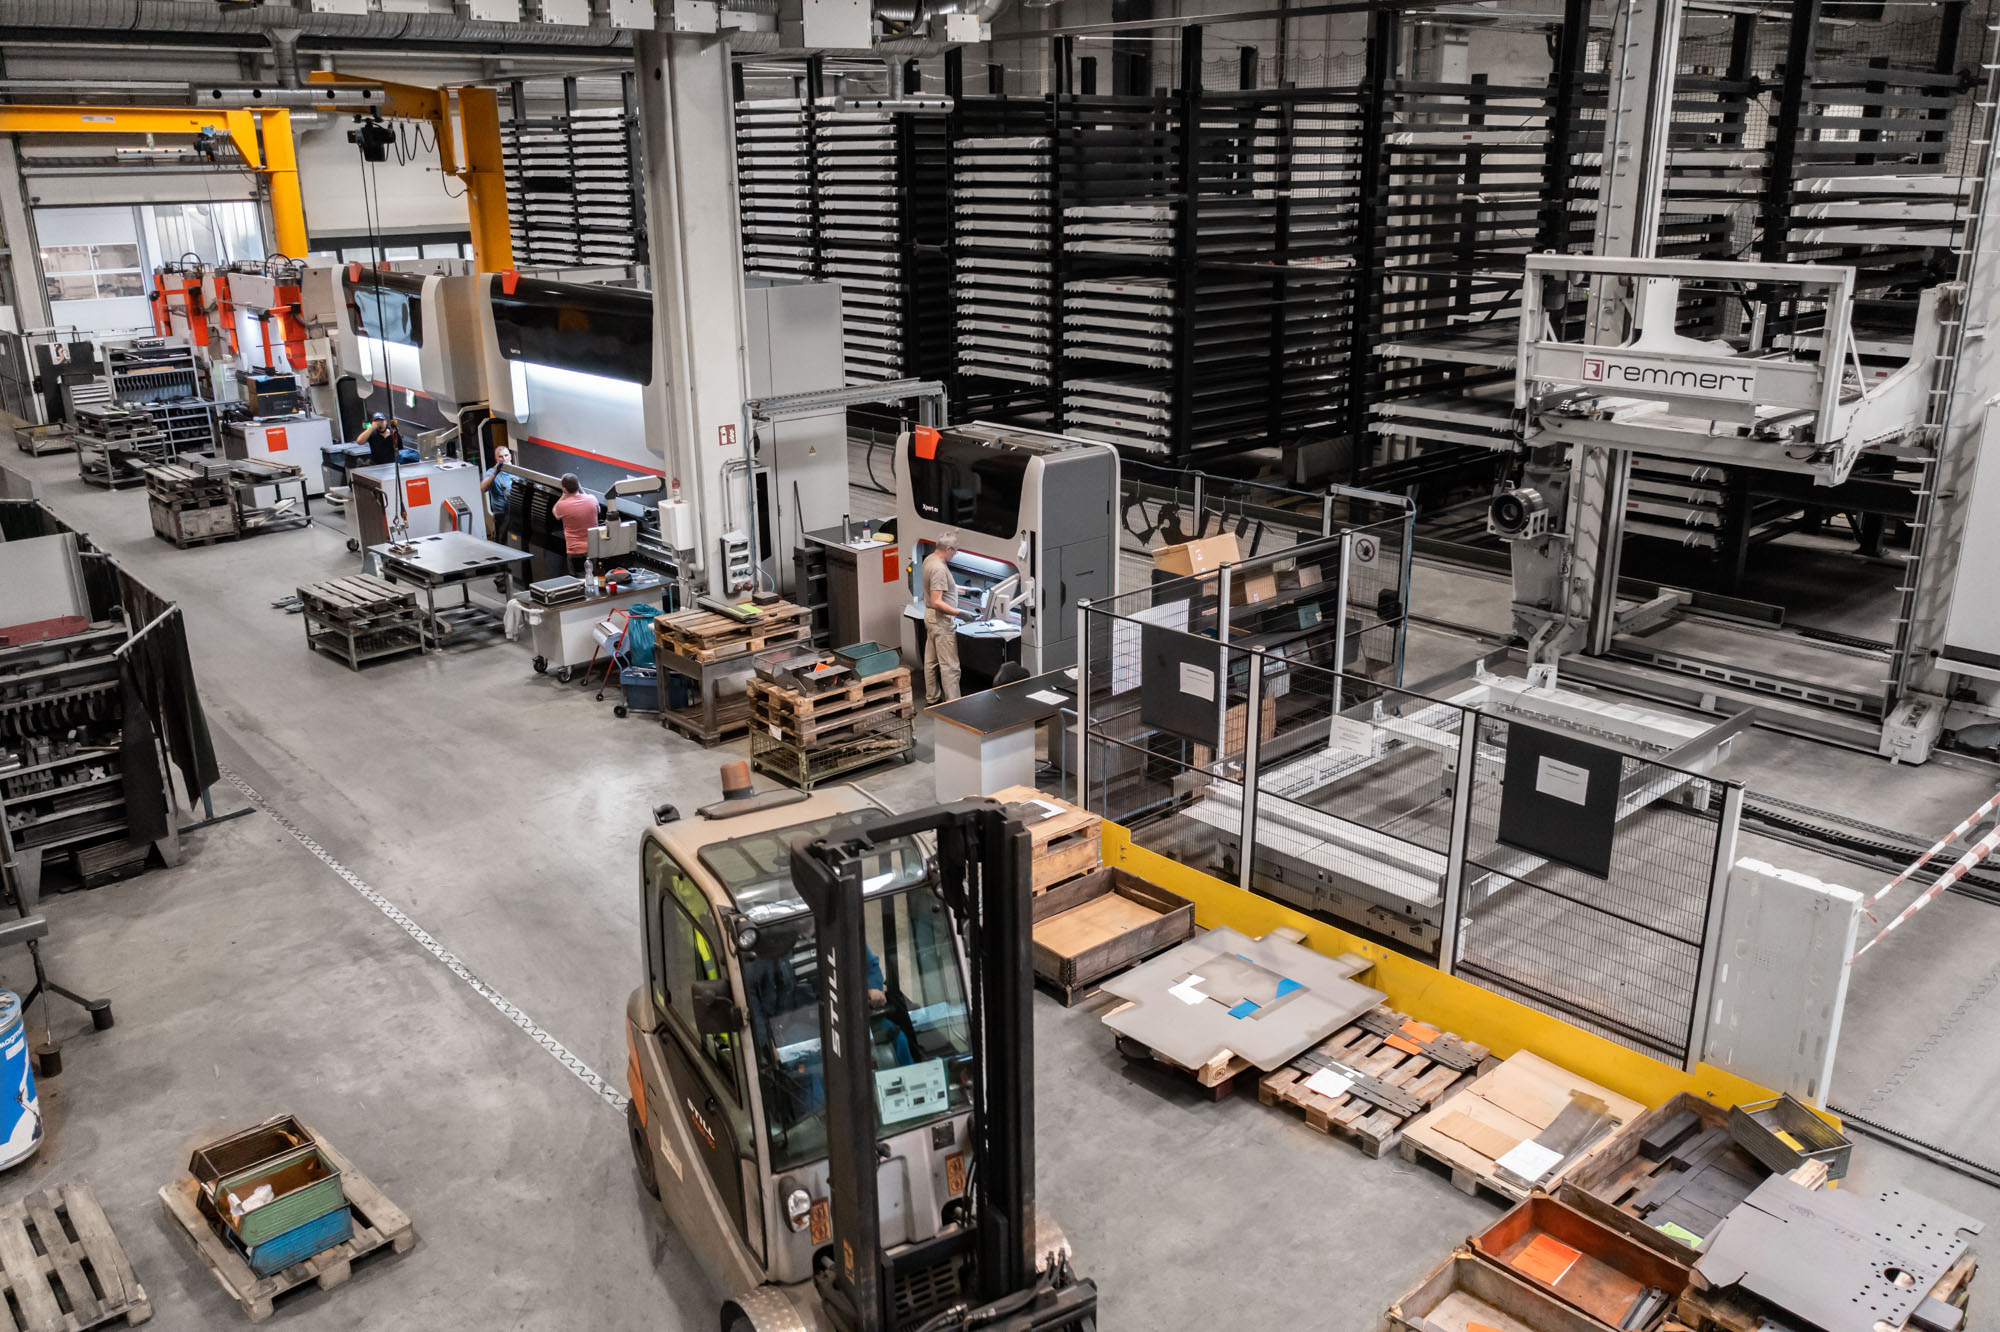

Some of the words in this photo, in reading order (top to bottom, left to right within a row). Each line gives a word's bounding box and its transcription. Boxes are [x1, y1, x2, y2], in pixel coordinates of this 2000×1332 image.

[1607, 364, 1754, 393] remmert
[827, 946, 841, 1058] STILL
[687, 1097, 716, 1141] STILL
